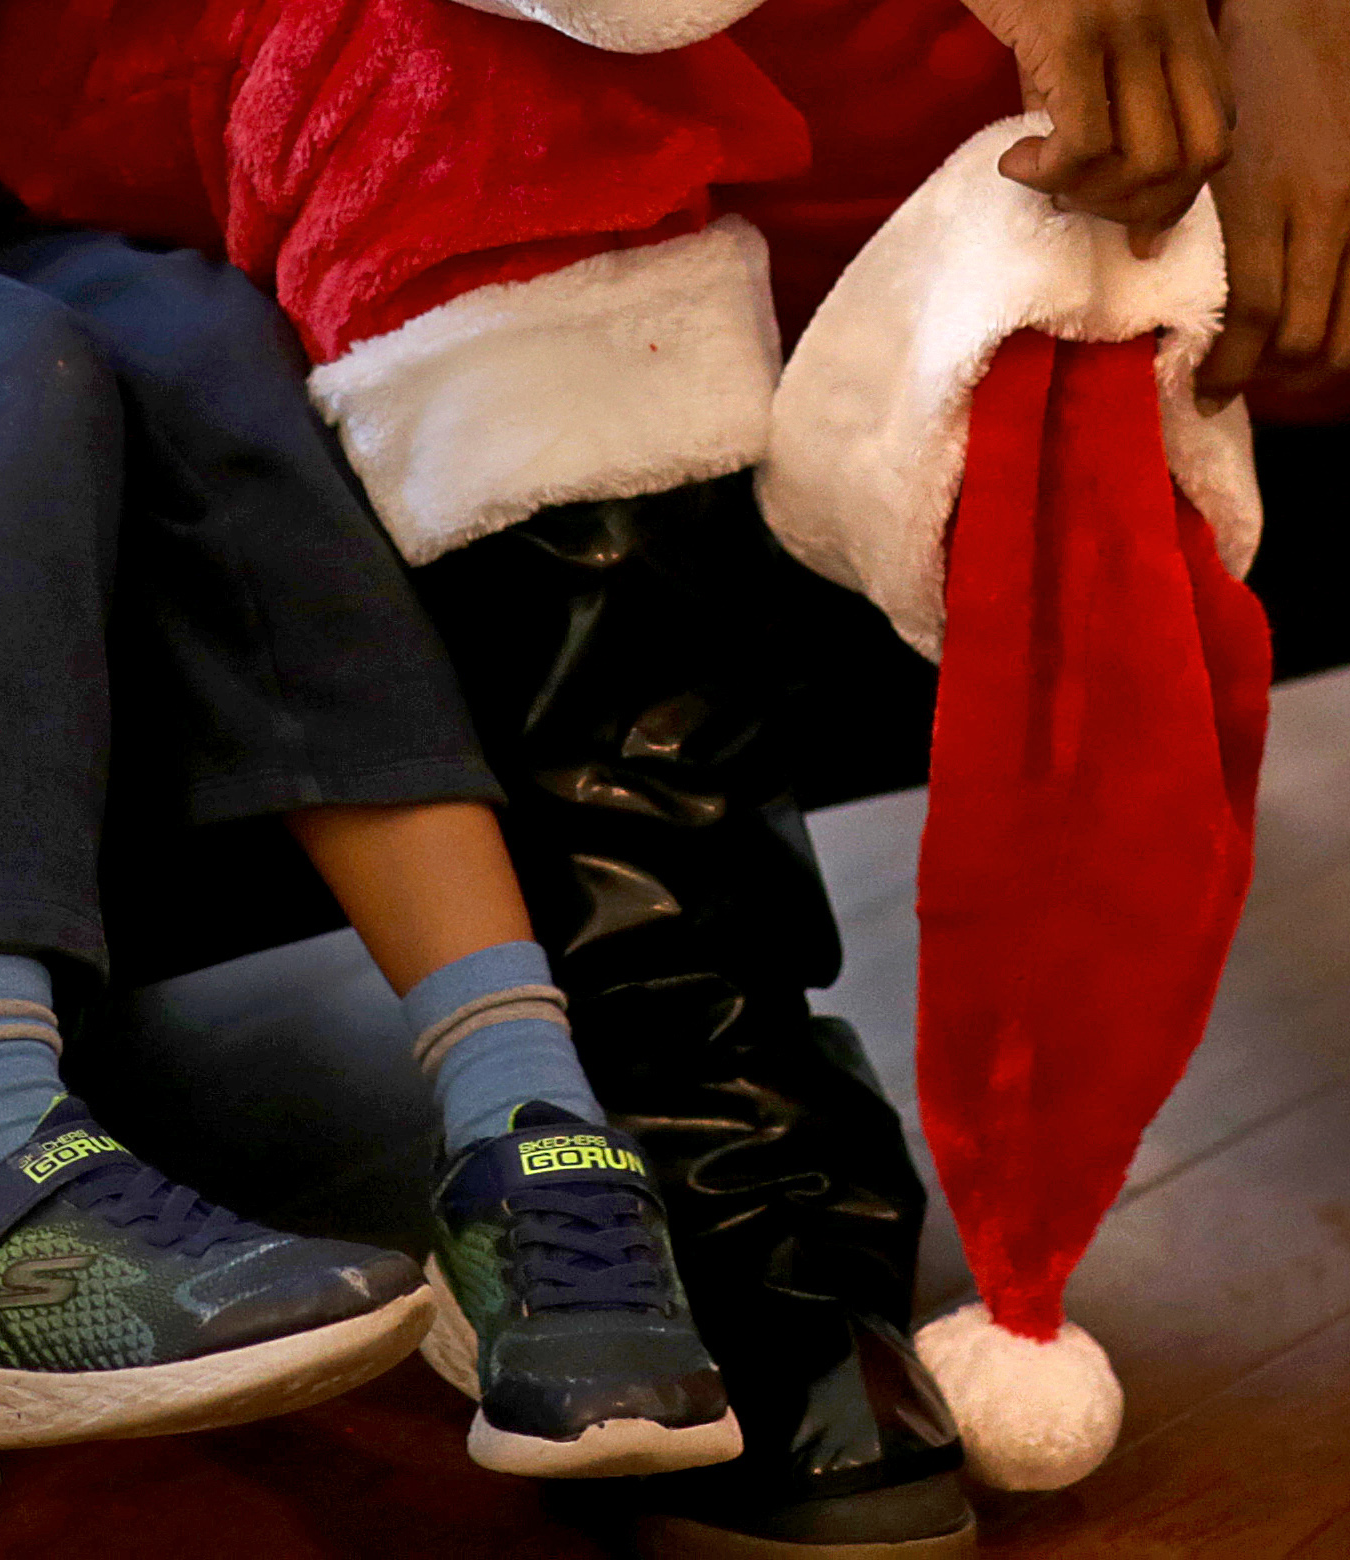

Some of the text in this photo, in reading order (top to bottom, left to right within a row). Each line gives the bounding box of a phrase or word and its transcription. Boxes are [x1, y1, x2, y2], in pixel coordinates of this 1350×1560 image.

[19, 1129, 89, 1169] SKCHERS
[518, 1134, 608, 1154] SKECHERS
[520, 1146, 646, 1176] GORUN
